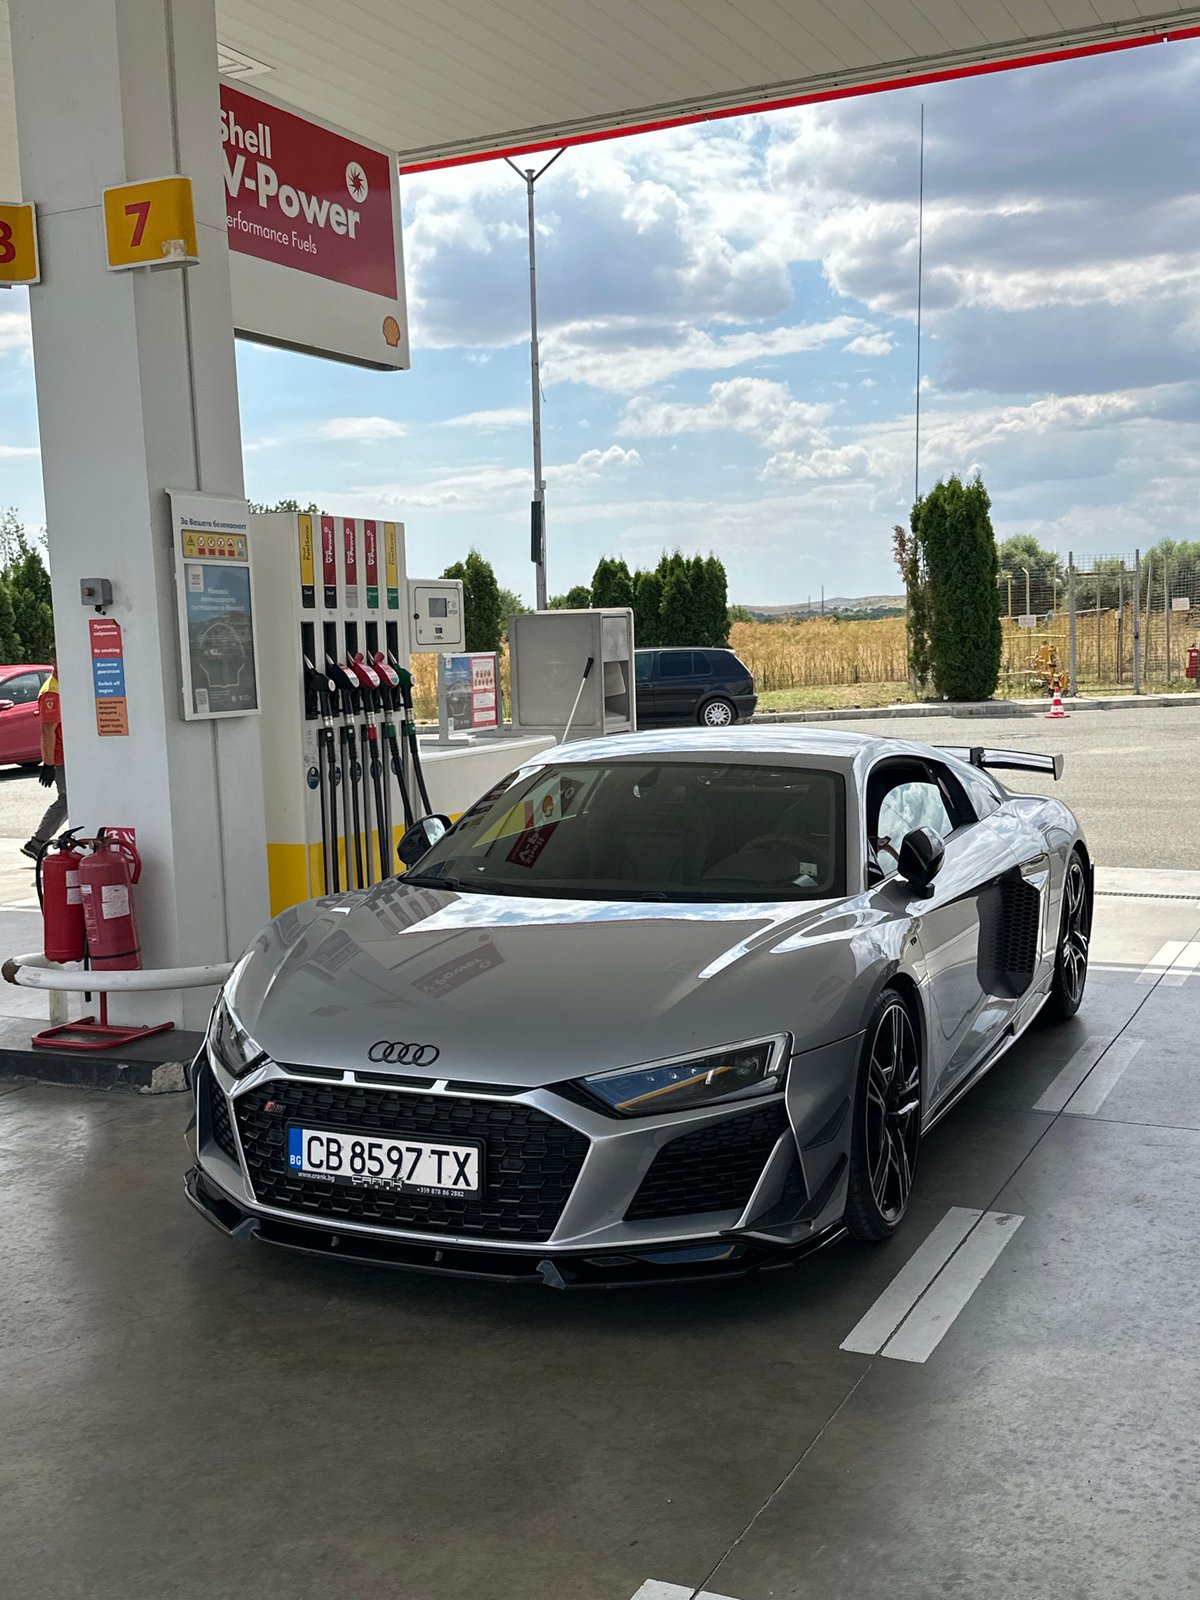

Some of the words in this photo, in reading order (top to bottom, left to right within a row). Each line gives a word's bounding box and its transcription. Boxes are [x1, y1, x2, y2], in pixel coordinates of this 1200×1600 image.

[219, 109, 272, 159] Shell
[222, 150, 360, 239] V-Power
[125, 201, 151, 247] 7
[226, 211, 289, 246] erformance
[292, 231, 317, 254] Fuels
[180, 517, 188, 525] За
[189, 518, 212, 527] Вашата
[290, 1155, 302, 1166] BG
[307, 1136, 343, 1171] CB
[350, 1141, 423, 1181] 8597
[430, 1150, 472, 1187] TX
